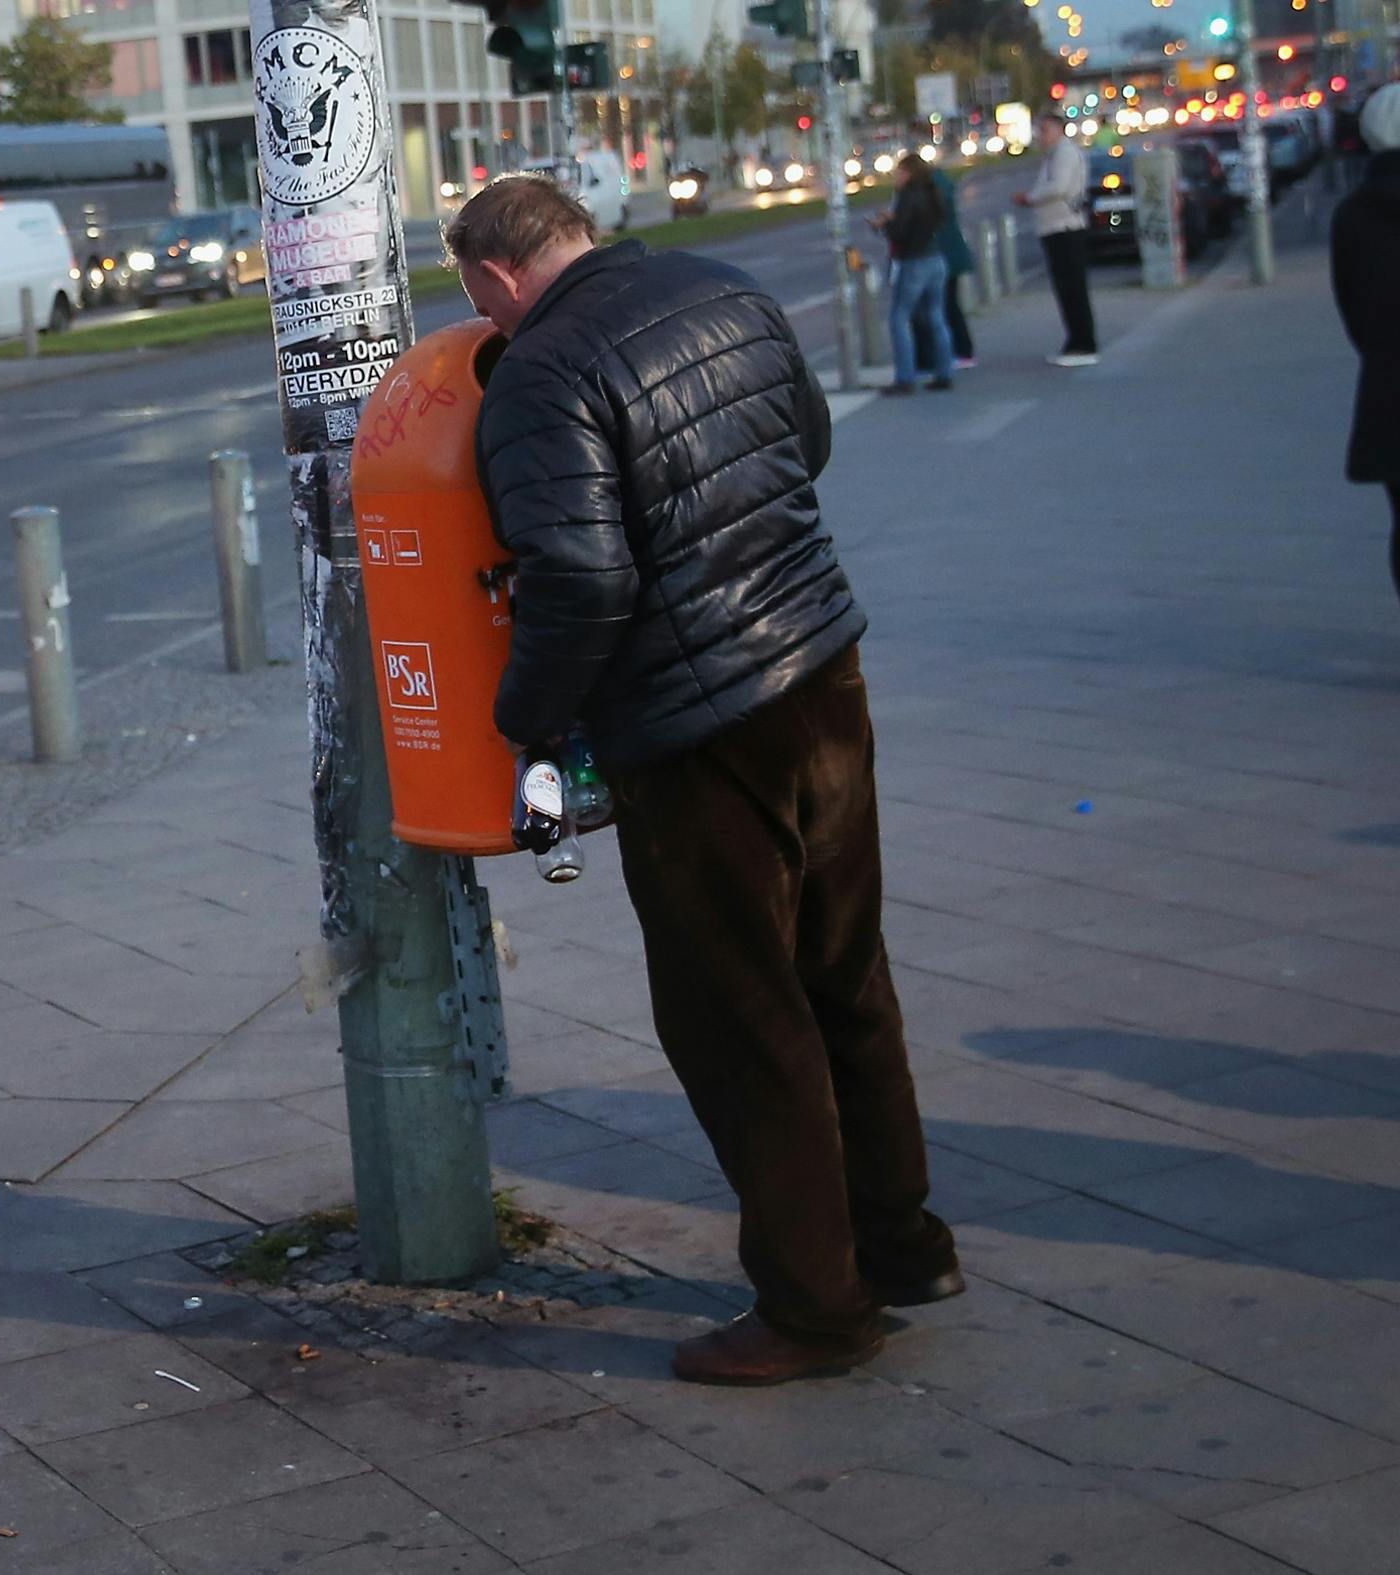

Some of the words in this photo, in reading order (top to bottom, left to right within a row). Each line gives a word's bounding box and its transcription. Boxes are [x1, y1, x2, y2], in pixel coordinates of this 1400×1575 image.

[287, 173, 312, 193] the
[381, 288, 395, 301] 23
[320, 307, 380, 329] BERLIN
[342, 338, 398, 362] 10pm
[319, 390, 347, 405] 8pm
[387, 654, 430, 696] BSR
